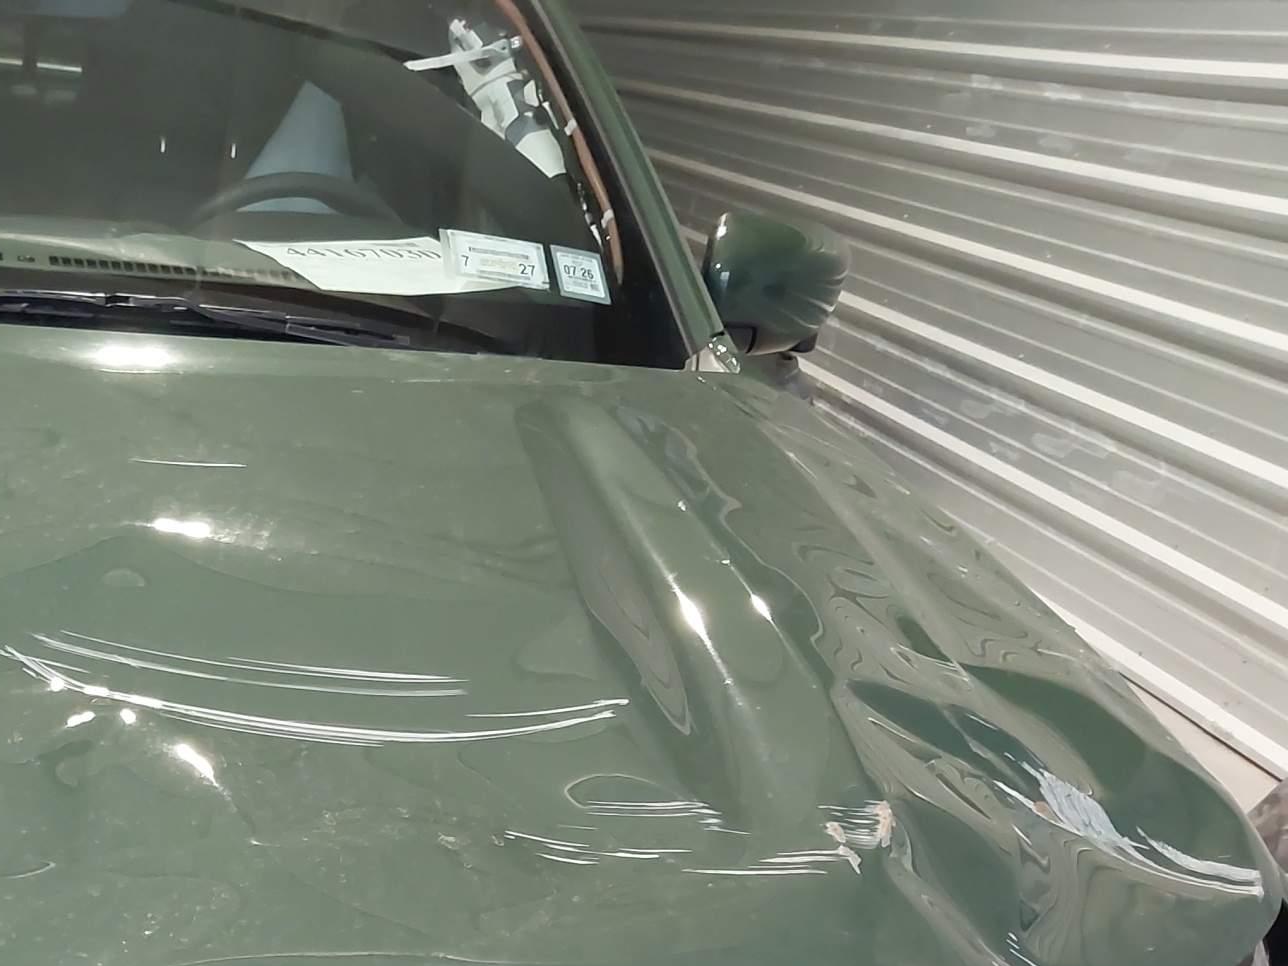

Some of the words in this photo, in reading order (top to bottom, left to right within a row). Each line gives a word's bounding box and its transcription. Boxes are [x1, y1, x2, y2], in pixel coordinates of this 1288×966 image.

[460, 254, 470, 267] 7
[518, 263, 536, 277] 27
[563, 264, 577, 276] 07
[580, 267, 594, 280] 26
